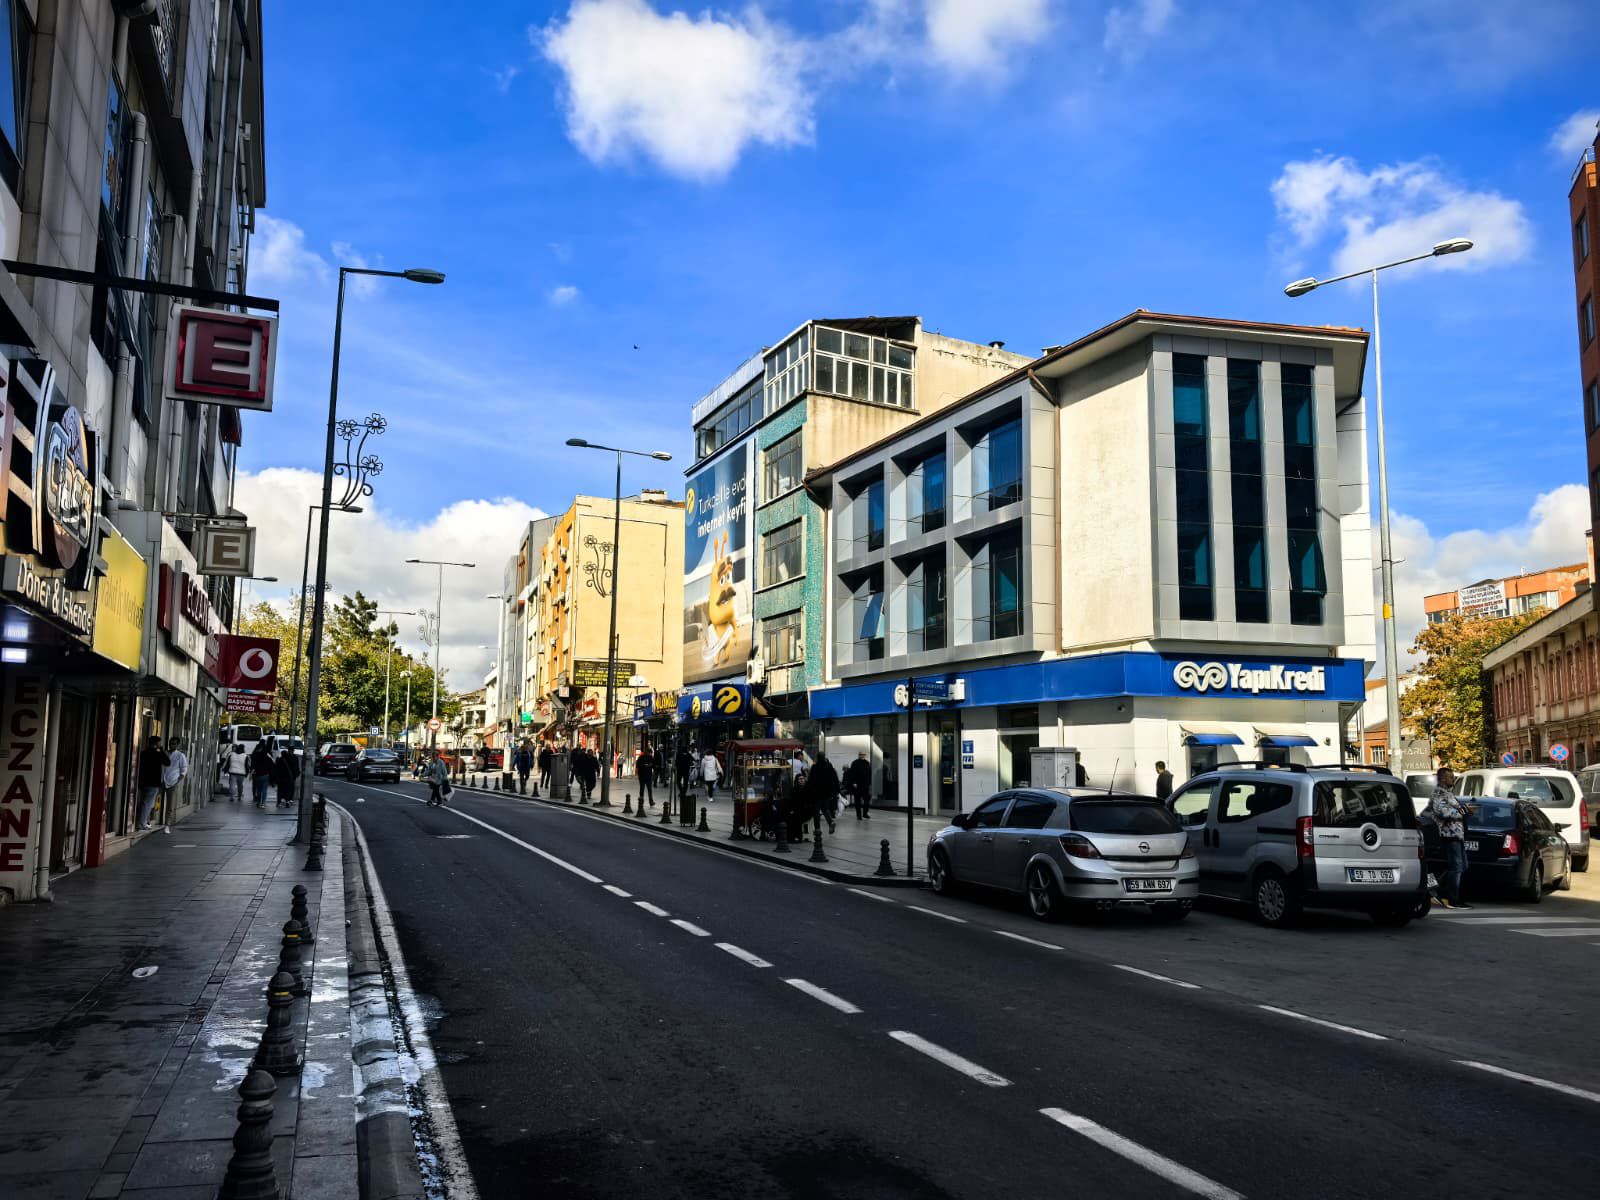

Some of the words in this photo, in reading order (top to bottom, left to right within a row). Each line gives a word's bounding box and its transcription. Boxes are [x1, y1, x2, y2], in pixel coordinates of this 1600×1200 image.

[193, 319, 252, 389] E
[697, 510, 725, 538] internet
[212, 534, 241, 566] E
[17, 557, 51, 609] Döner
[52, 578, 60, 616] &
[1226, 663, 1326, 694] YapıKredi
[0, 675, 41, 872] ECZANE
